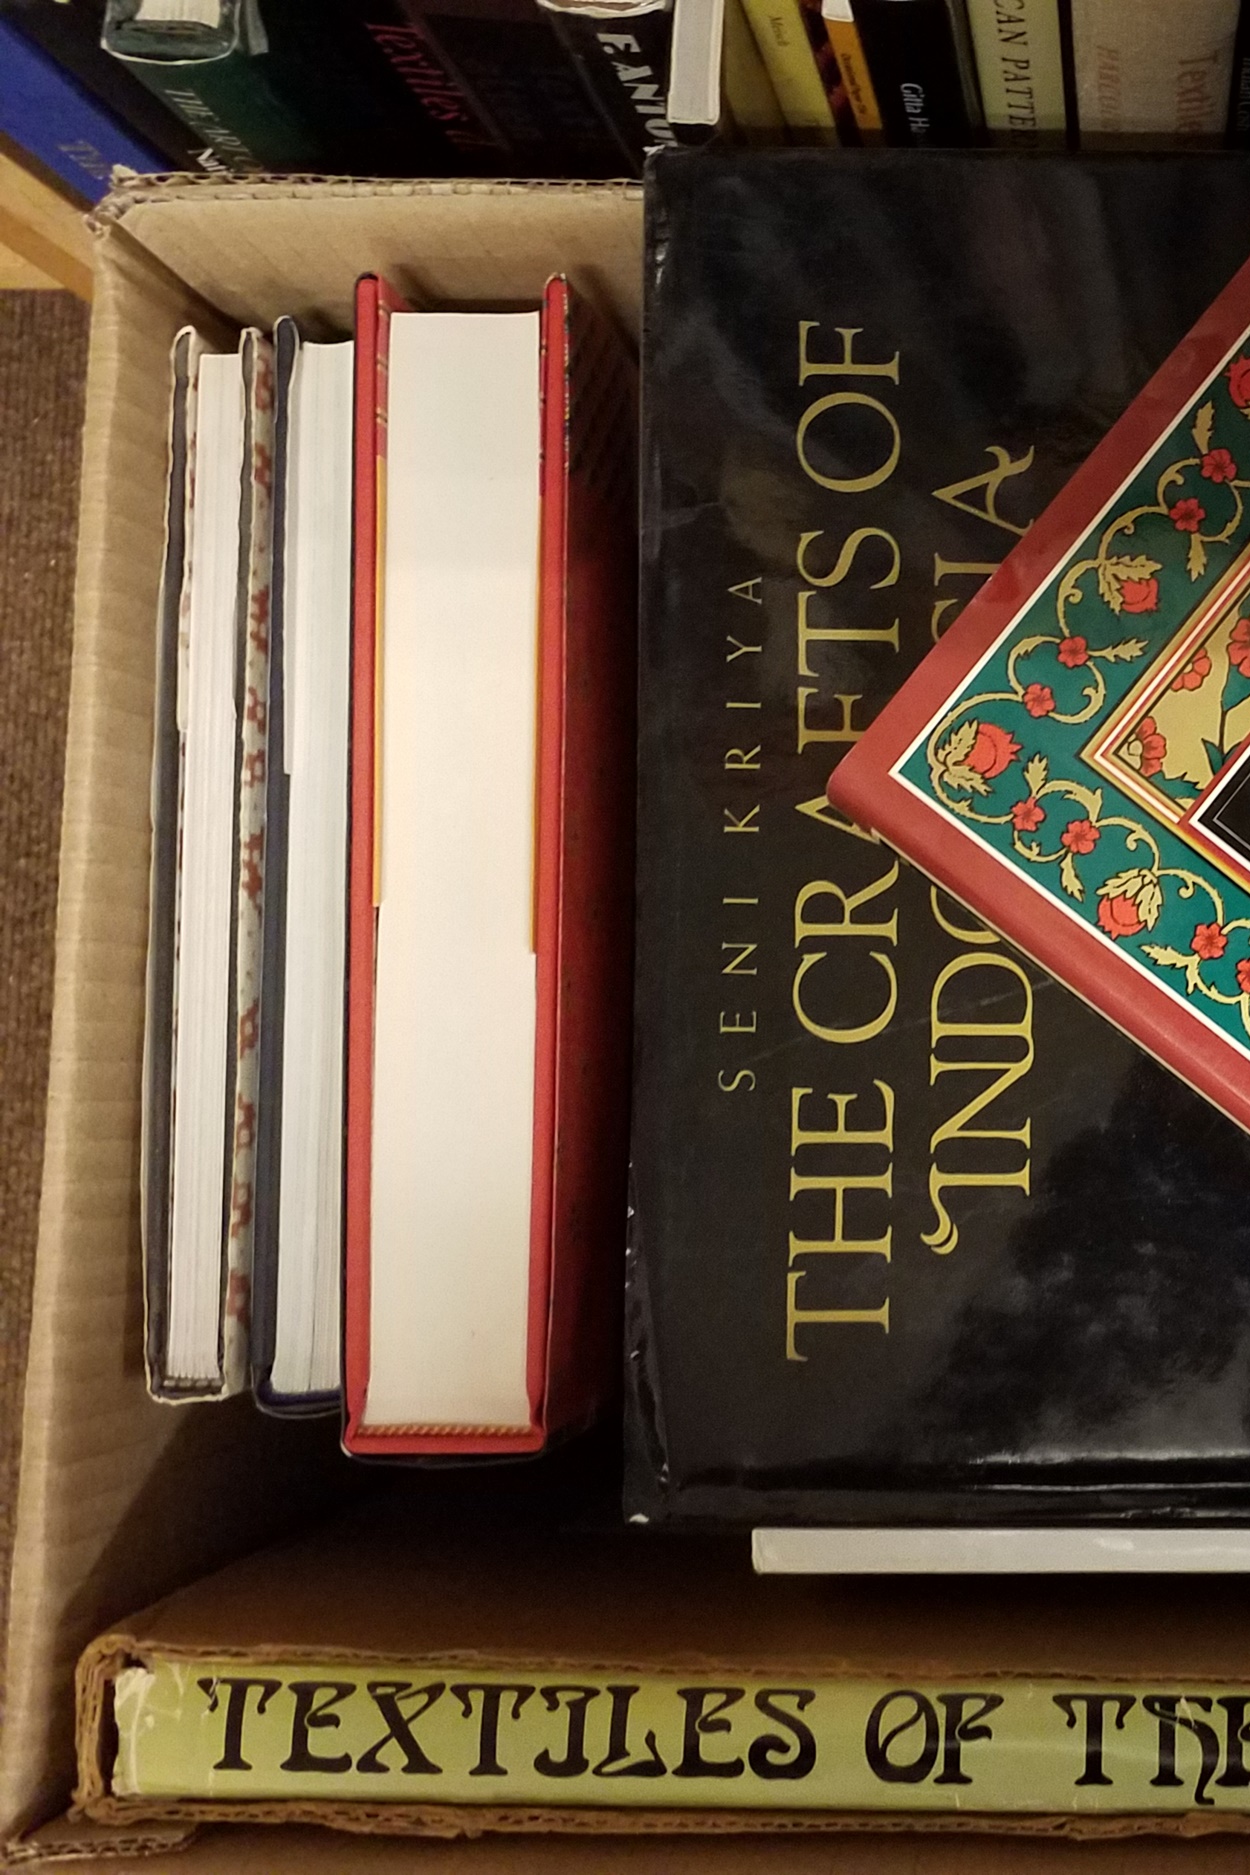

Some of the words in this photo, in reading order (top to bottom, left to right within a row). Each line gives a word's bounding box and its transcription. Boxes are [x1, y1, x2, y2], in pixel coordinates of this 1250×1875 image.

[363, 22, 468, 123] Textiles
[796, 320, 900, 493] OF
[723, 576, 763, 834] KRIYA
[920, 445, 1035, 1255] INDIA
[717, 897, 759, 1092] SENI
[786, 1080, 896, 1362] THE
[198, 1676, 818, 1780] TEXTILES
[863, 1689, 1004, 1786] OF
